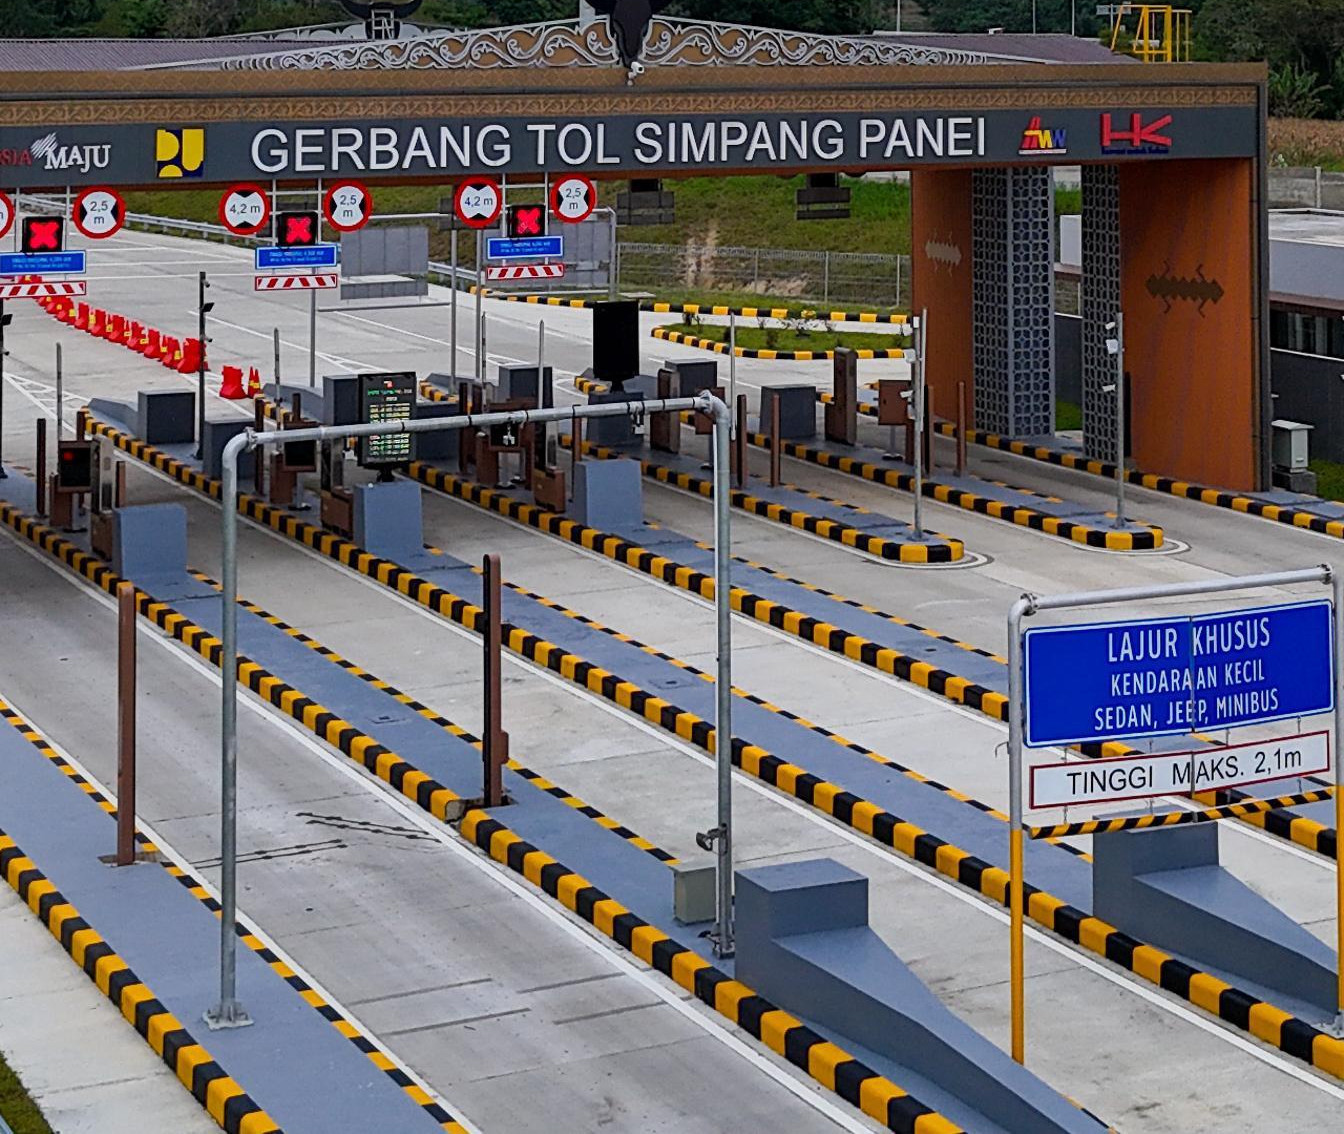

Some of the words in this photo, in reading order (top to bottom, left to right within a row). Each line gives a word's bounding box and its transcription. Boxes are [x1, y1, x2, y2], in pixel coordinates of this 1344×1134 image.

[251, 123, 512, 173] GERBANG
[526, 122, 621, 166] TOL
[633, 119, 845, 165] SIMPANG
[859, 117, 986, 159] PANEI
[44, 144, 112, 173] MAJU
[564, 187, 583, 200] 2,5
[89, 200, 109, 214] 2,5
[339, 194, 358, 207] 2,5
[464, 196, 482, 208] 4,2
[483, 197, 494, 206] m
[568, 201, 579, 210] m
[229, 203, 248, 216] 4,2
[250, 205, 261, 214] m
[342, 209, 354, 218] m
[93, 216, 105, 225] m
[1107, 627, 1179, 663] LAJUR
[1192, 616, 1271, 657] KHUSUS
[1111, 665, 1218, 698] KENDARAAN
[1224, 658, 1265, 687] KECIL
[1094, 702, 1158, 732] SEDAN,
[1166, 700, 1209, 725] JEEP,
[1216, 687, 1280, 720] MINIBUS
[1066, 765, 1154, 796] TINGGI
[1171, 755, 1245, 786] MAKS.
[1253, 746, 1302, 776] 2,1m
